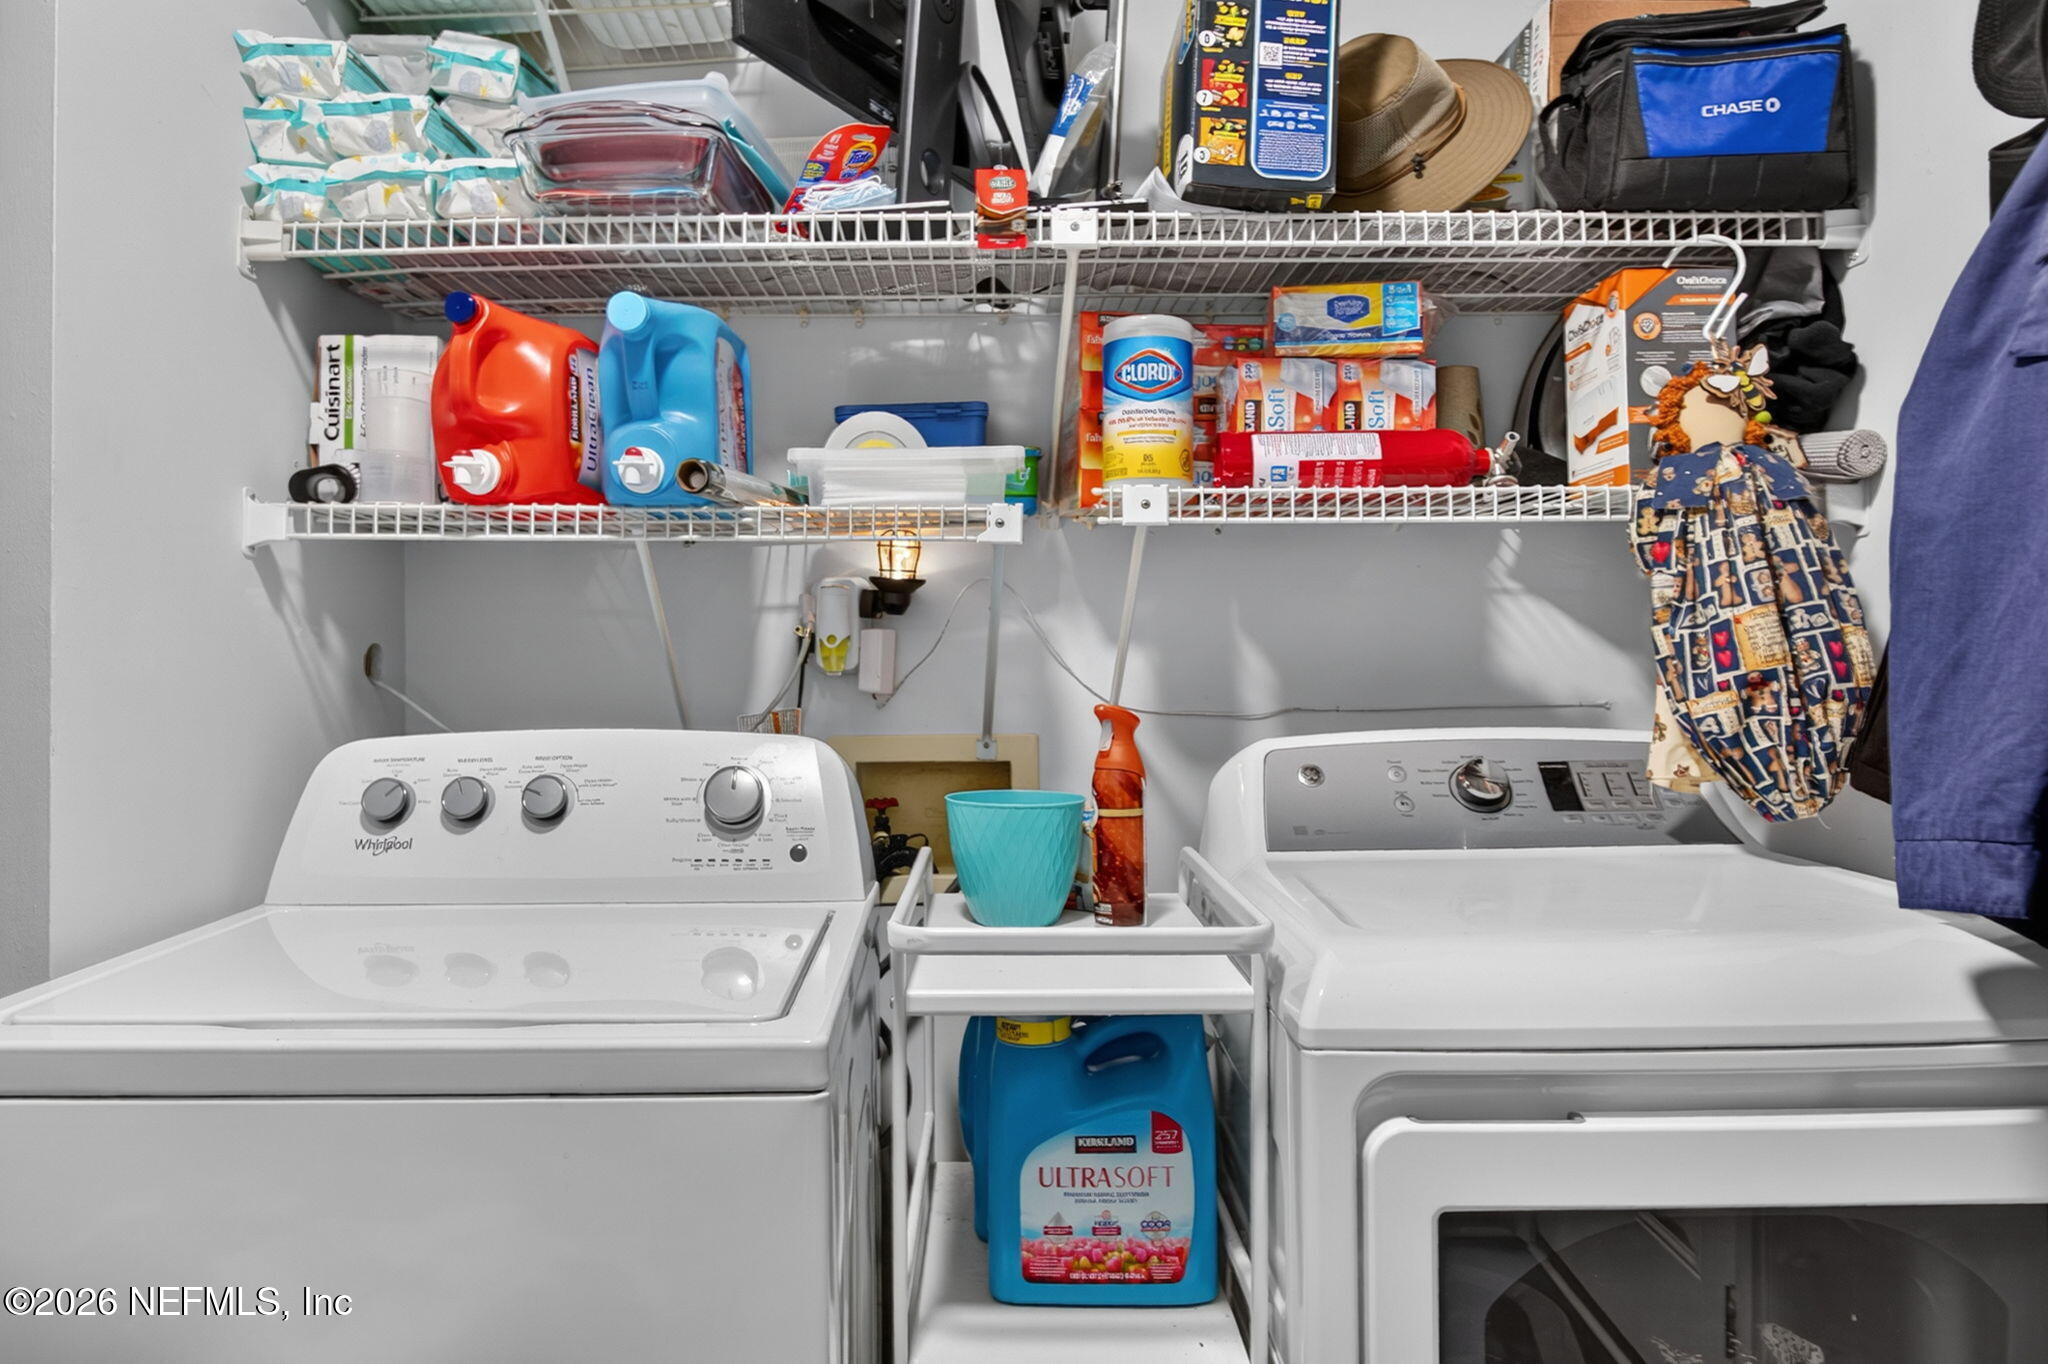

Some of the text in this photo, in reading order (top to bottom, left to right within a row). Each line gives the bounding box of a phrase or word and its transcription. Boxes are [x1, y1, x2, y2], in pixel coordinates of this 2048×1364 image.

[1701, 99, 1763, 117] CHASE
[1121, 362, 1177, 382] CLOROX
[324, 344, 341, 441] Cuisinart
[586, 367, 598, 471] UltraClean
[354, 836, 413, 856] Whirlpool
[1077, 1137, 1135, 1147] KIRKLAND
